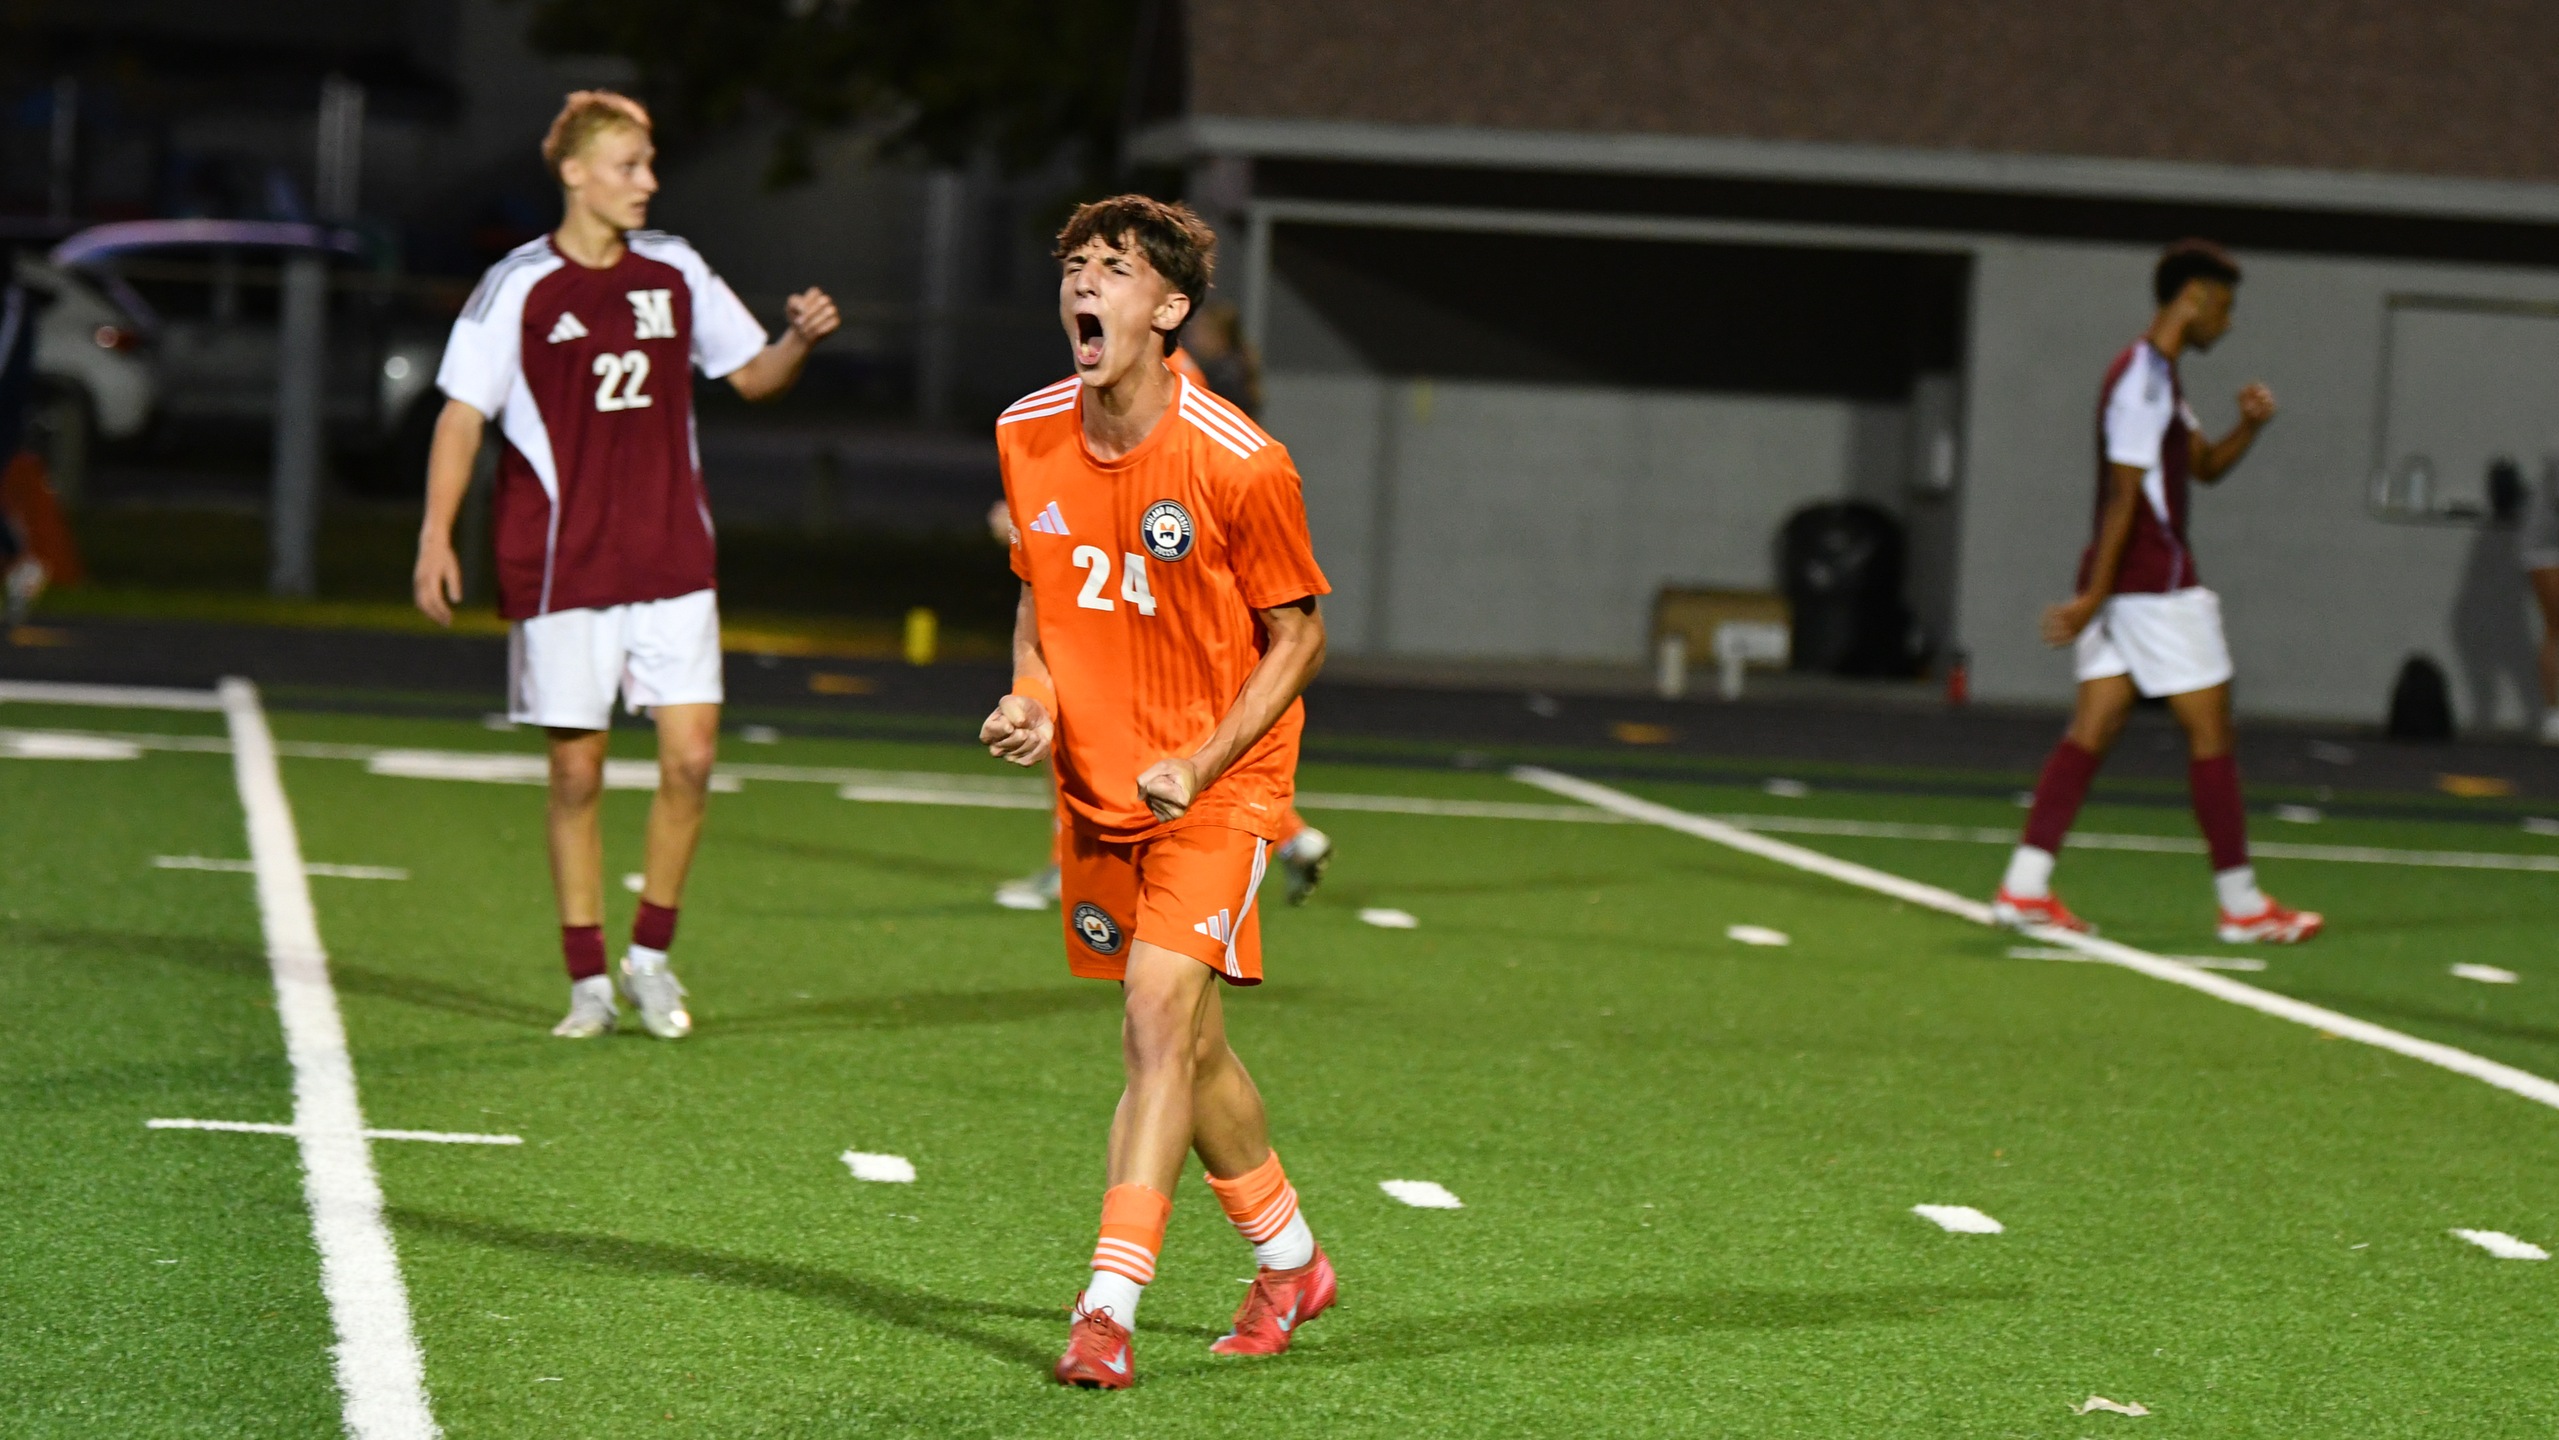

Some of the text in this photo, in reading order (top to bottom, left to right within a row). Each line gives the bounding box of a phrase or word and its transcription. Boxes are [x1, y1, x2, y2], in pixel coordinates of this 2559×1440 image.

[592, 350, 652, 411] 22
[1144, 506, 1190, 536] MIDLAND UNIVERSITY
[1072, 545, 1157, 616] 24
